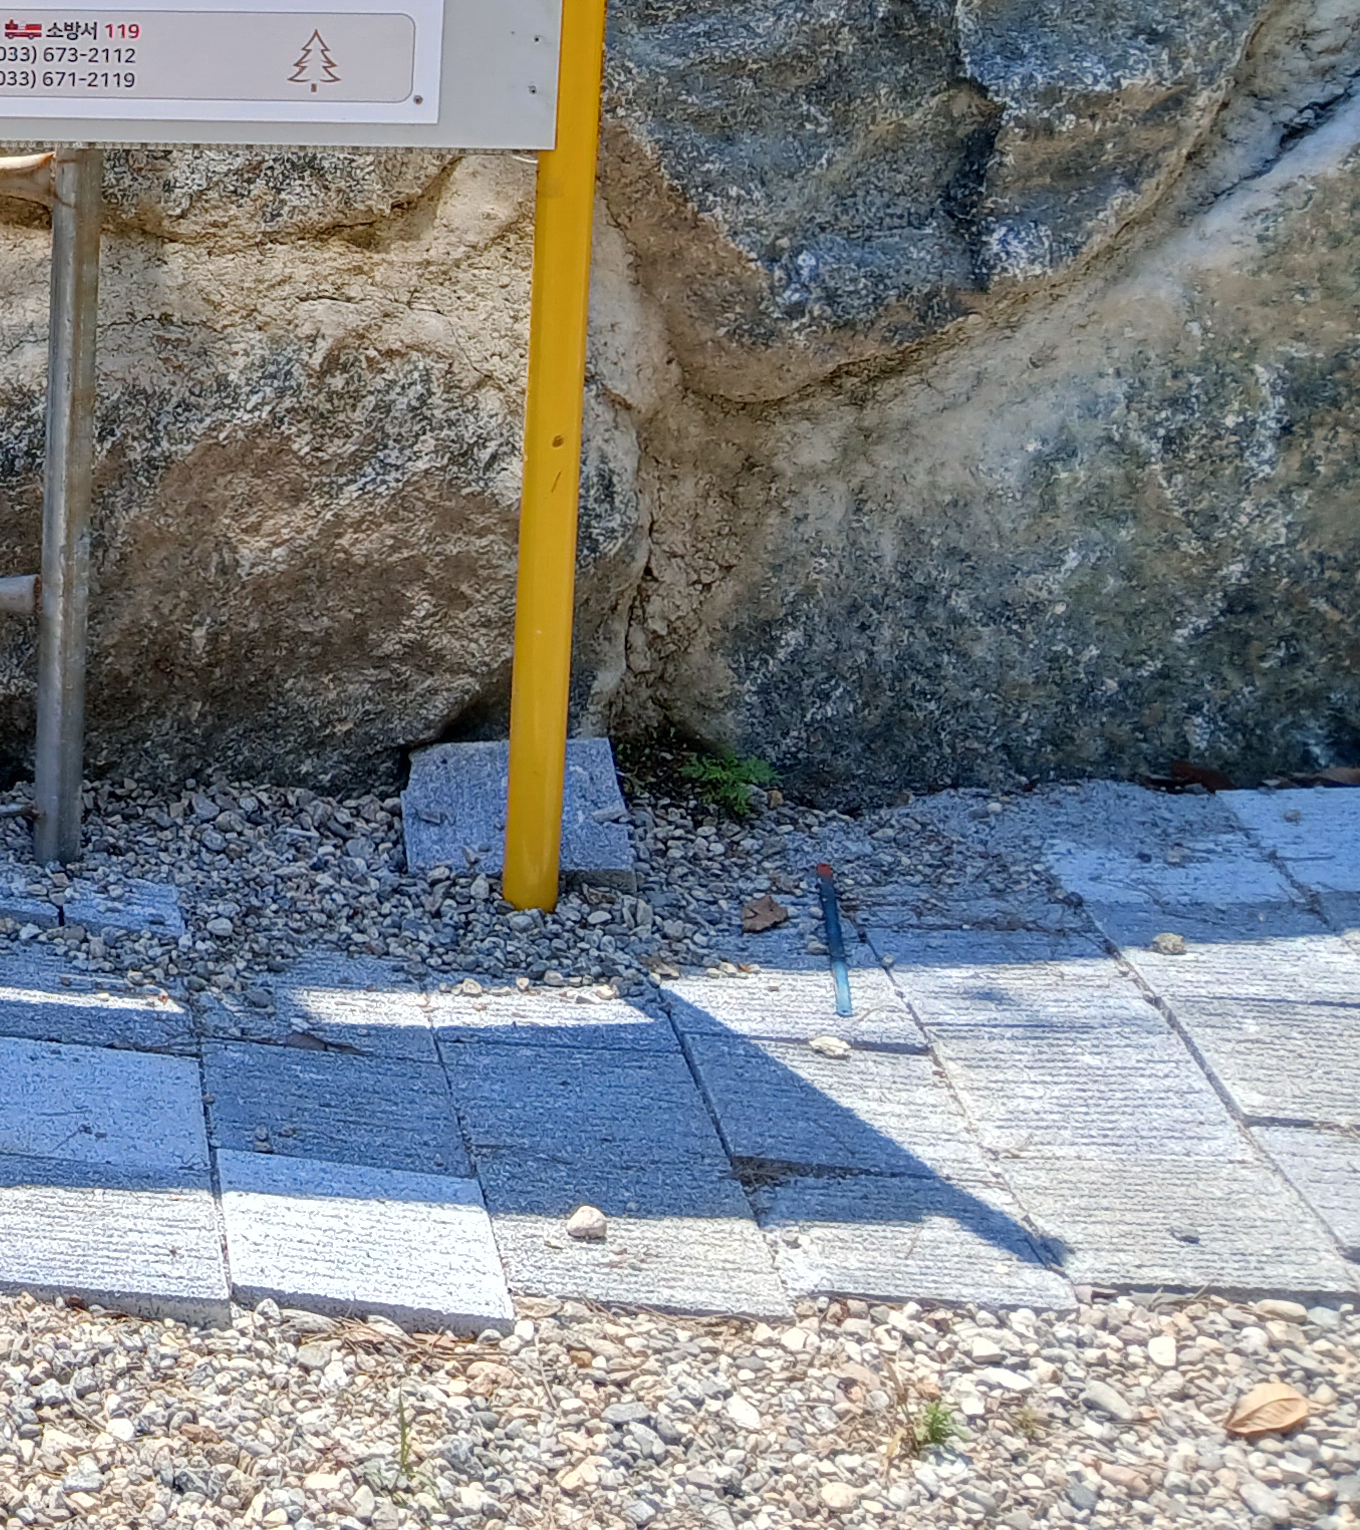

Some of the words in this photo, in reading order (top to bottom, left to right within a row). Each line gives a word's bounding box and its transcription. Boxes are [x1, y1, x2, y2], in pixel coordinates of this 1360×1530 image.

[46, 22, 97, 41] 소방서
[105, 24, 139, 39] 119
[44, 47, 135, 63] 673-2112
[42, 71, 135, 88] 671-2119
